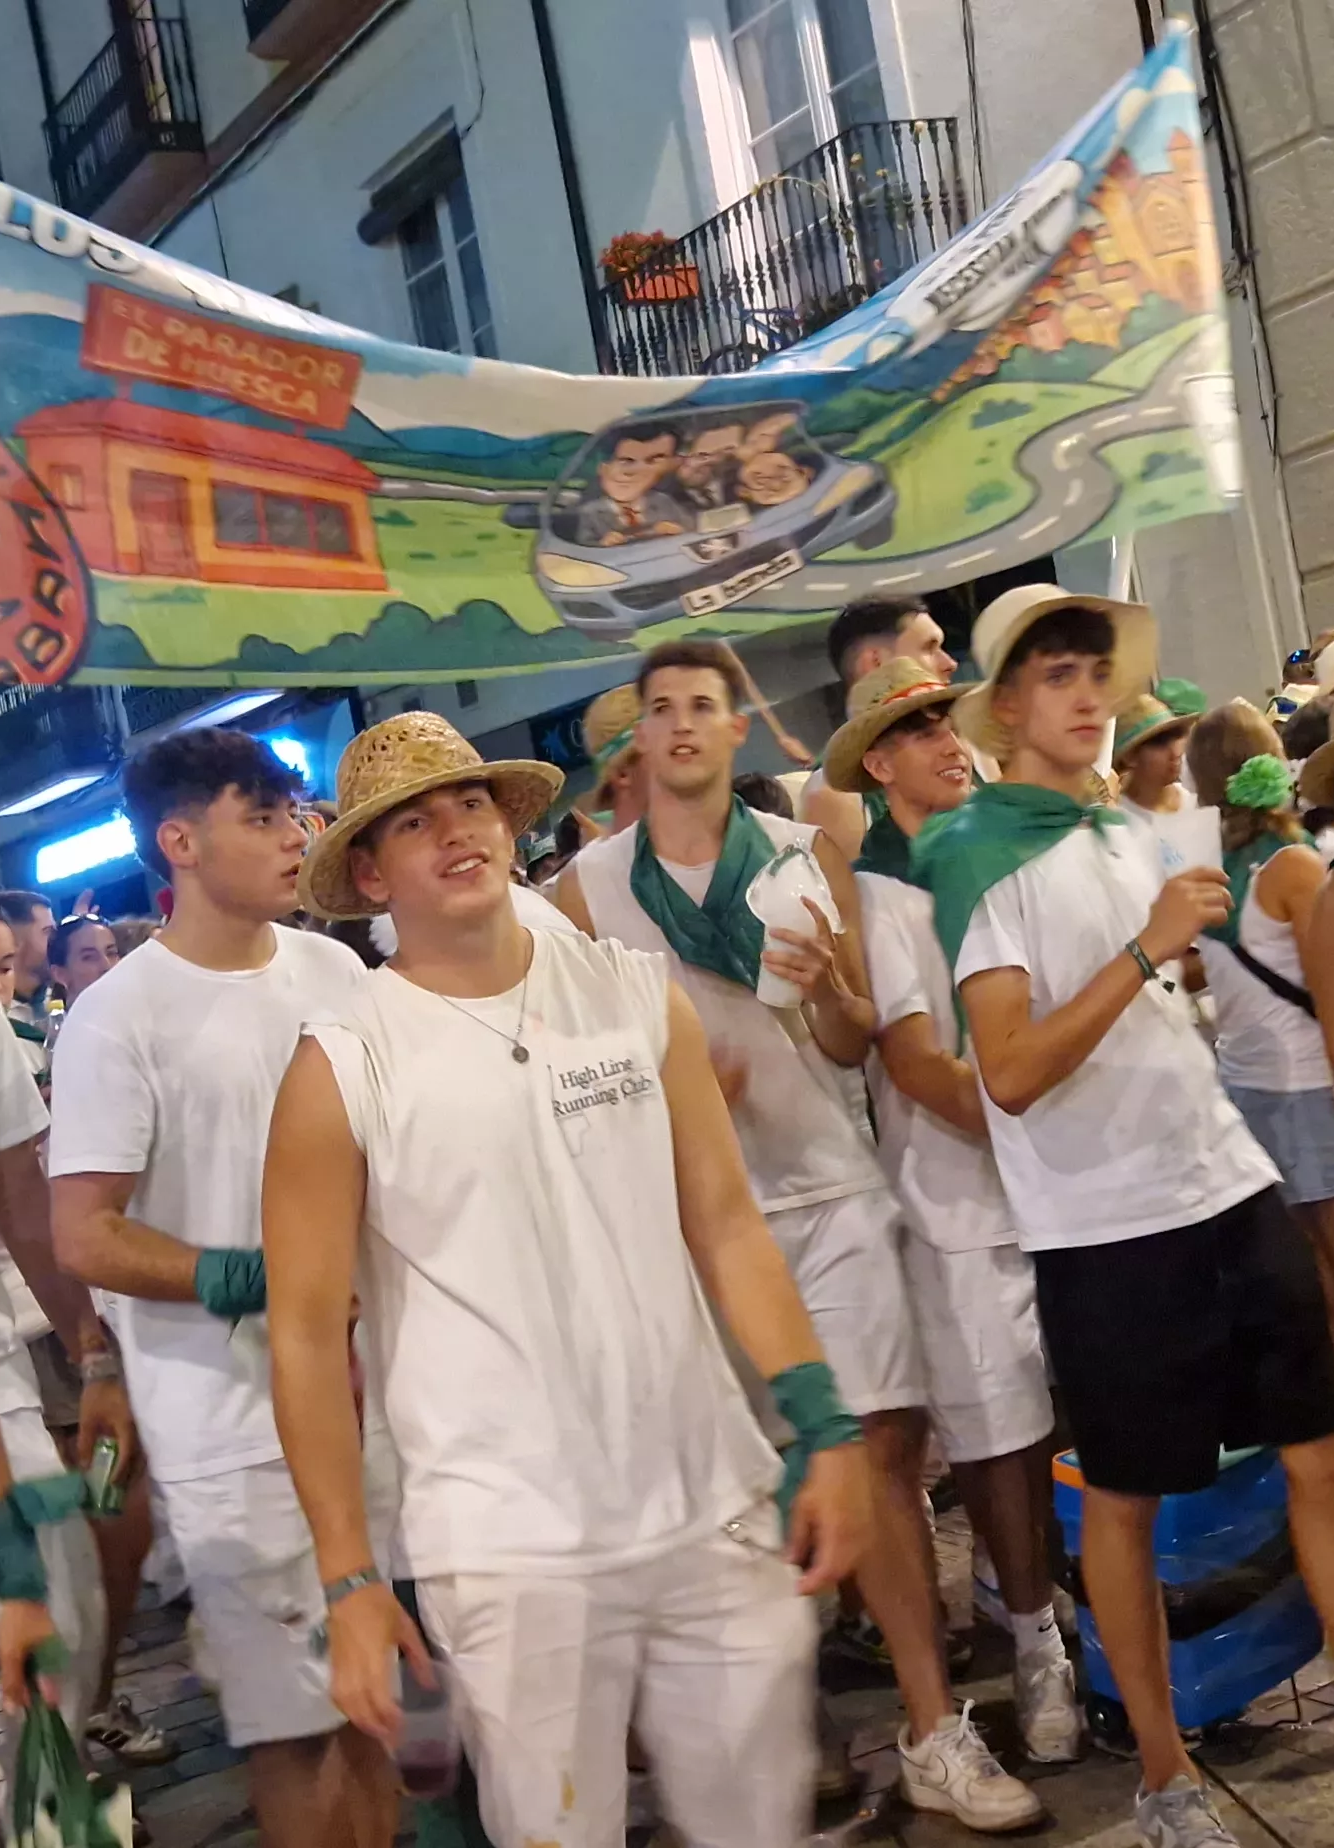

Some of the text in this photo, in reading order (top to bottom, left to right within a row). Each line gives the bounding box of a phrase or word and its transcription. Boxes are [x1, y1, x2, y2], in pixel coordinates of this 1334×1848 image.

[111, 298, 155, 330] EL
[163, 316, 346, 388] PARADOR
[123, 326, 318, 415] DE HUESCA
[551, 1075, 653, 1118] Running Club
[558, 1058, 633, 1090] High Line
